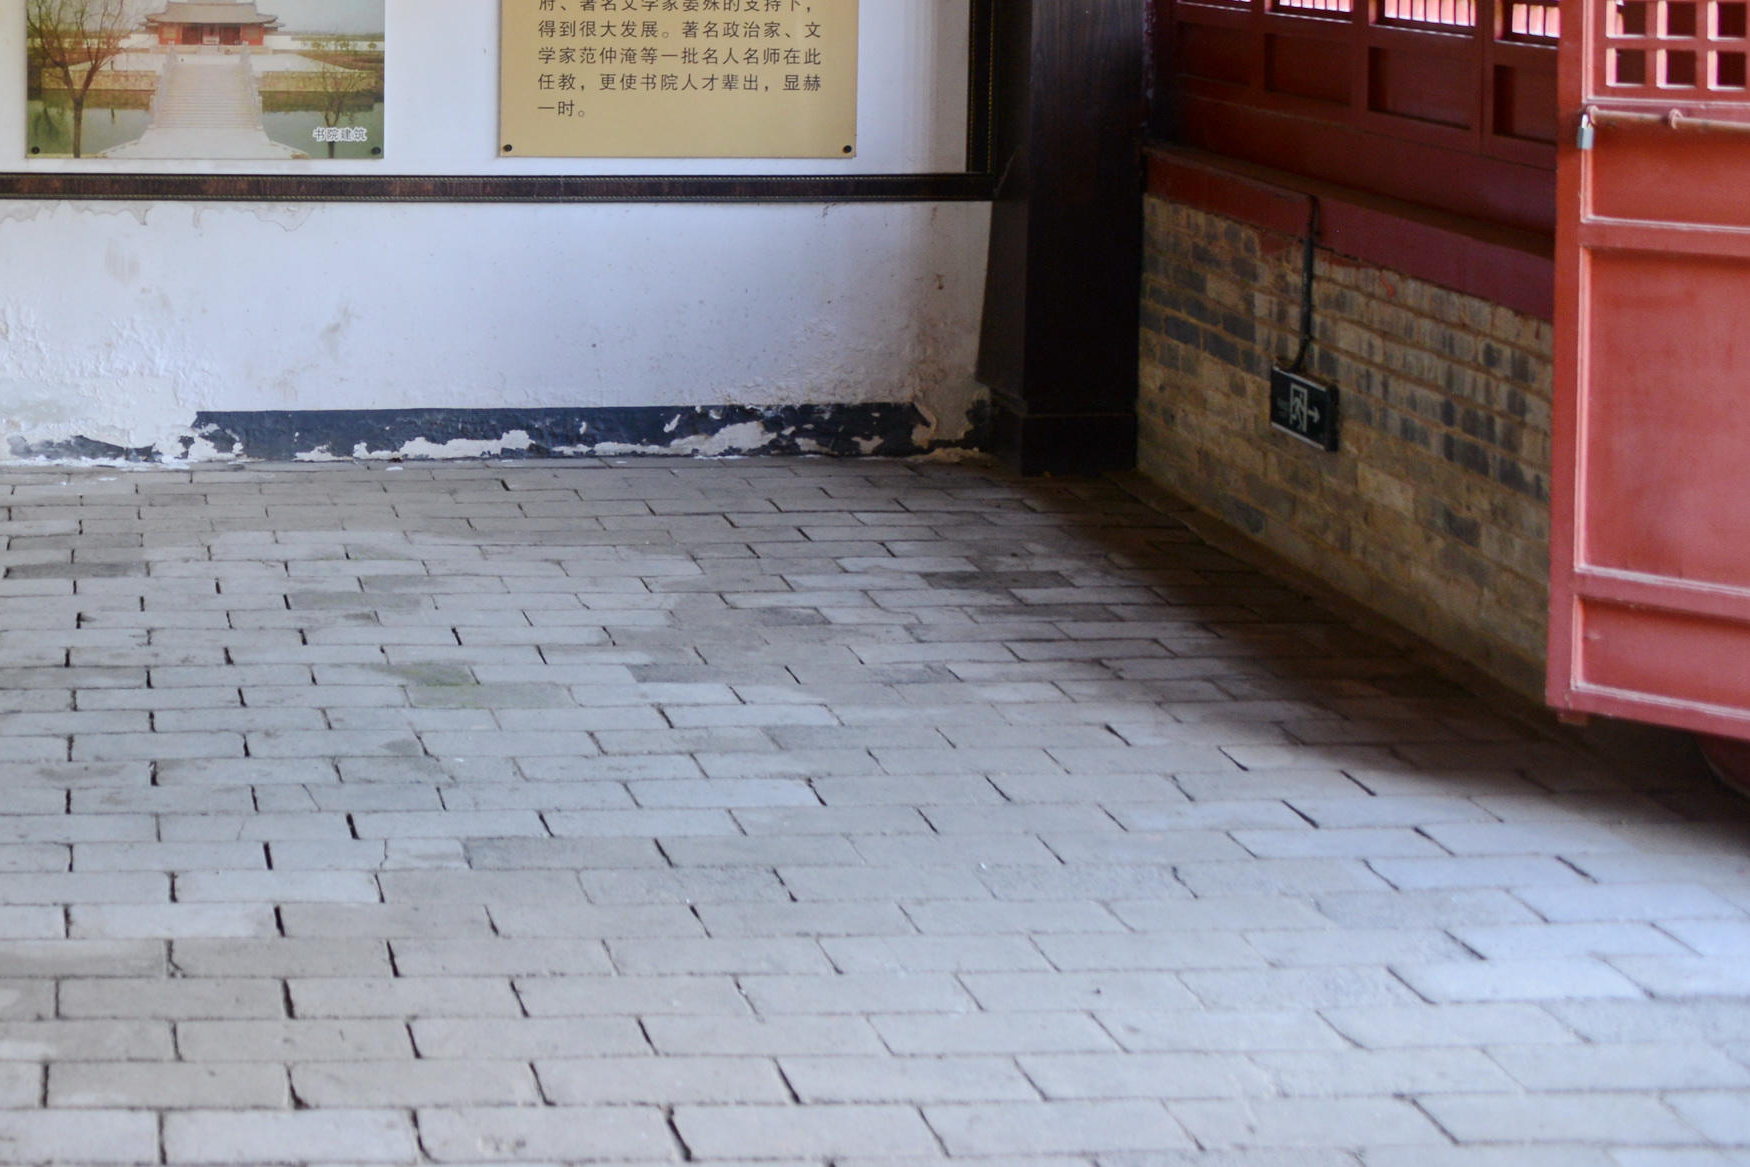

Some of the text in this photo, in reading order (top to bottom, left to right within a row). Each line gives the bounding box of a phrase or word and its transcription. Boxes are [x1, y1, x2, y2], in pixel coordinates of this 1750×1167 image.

[538, 20, 822, 39] 得到很大发展。著名政治家、文
[538, 47, 822, 65] 学家范仲淹等一批名人名师在此
[538, 73, 822, 92] 任教，更使书院人才辈出，显赫
[538, 101, 586, 118] 一时。
[313, 127, 367, 142] 书院建筑
